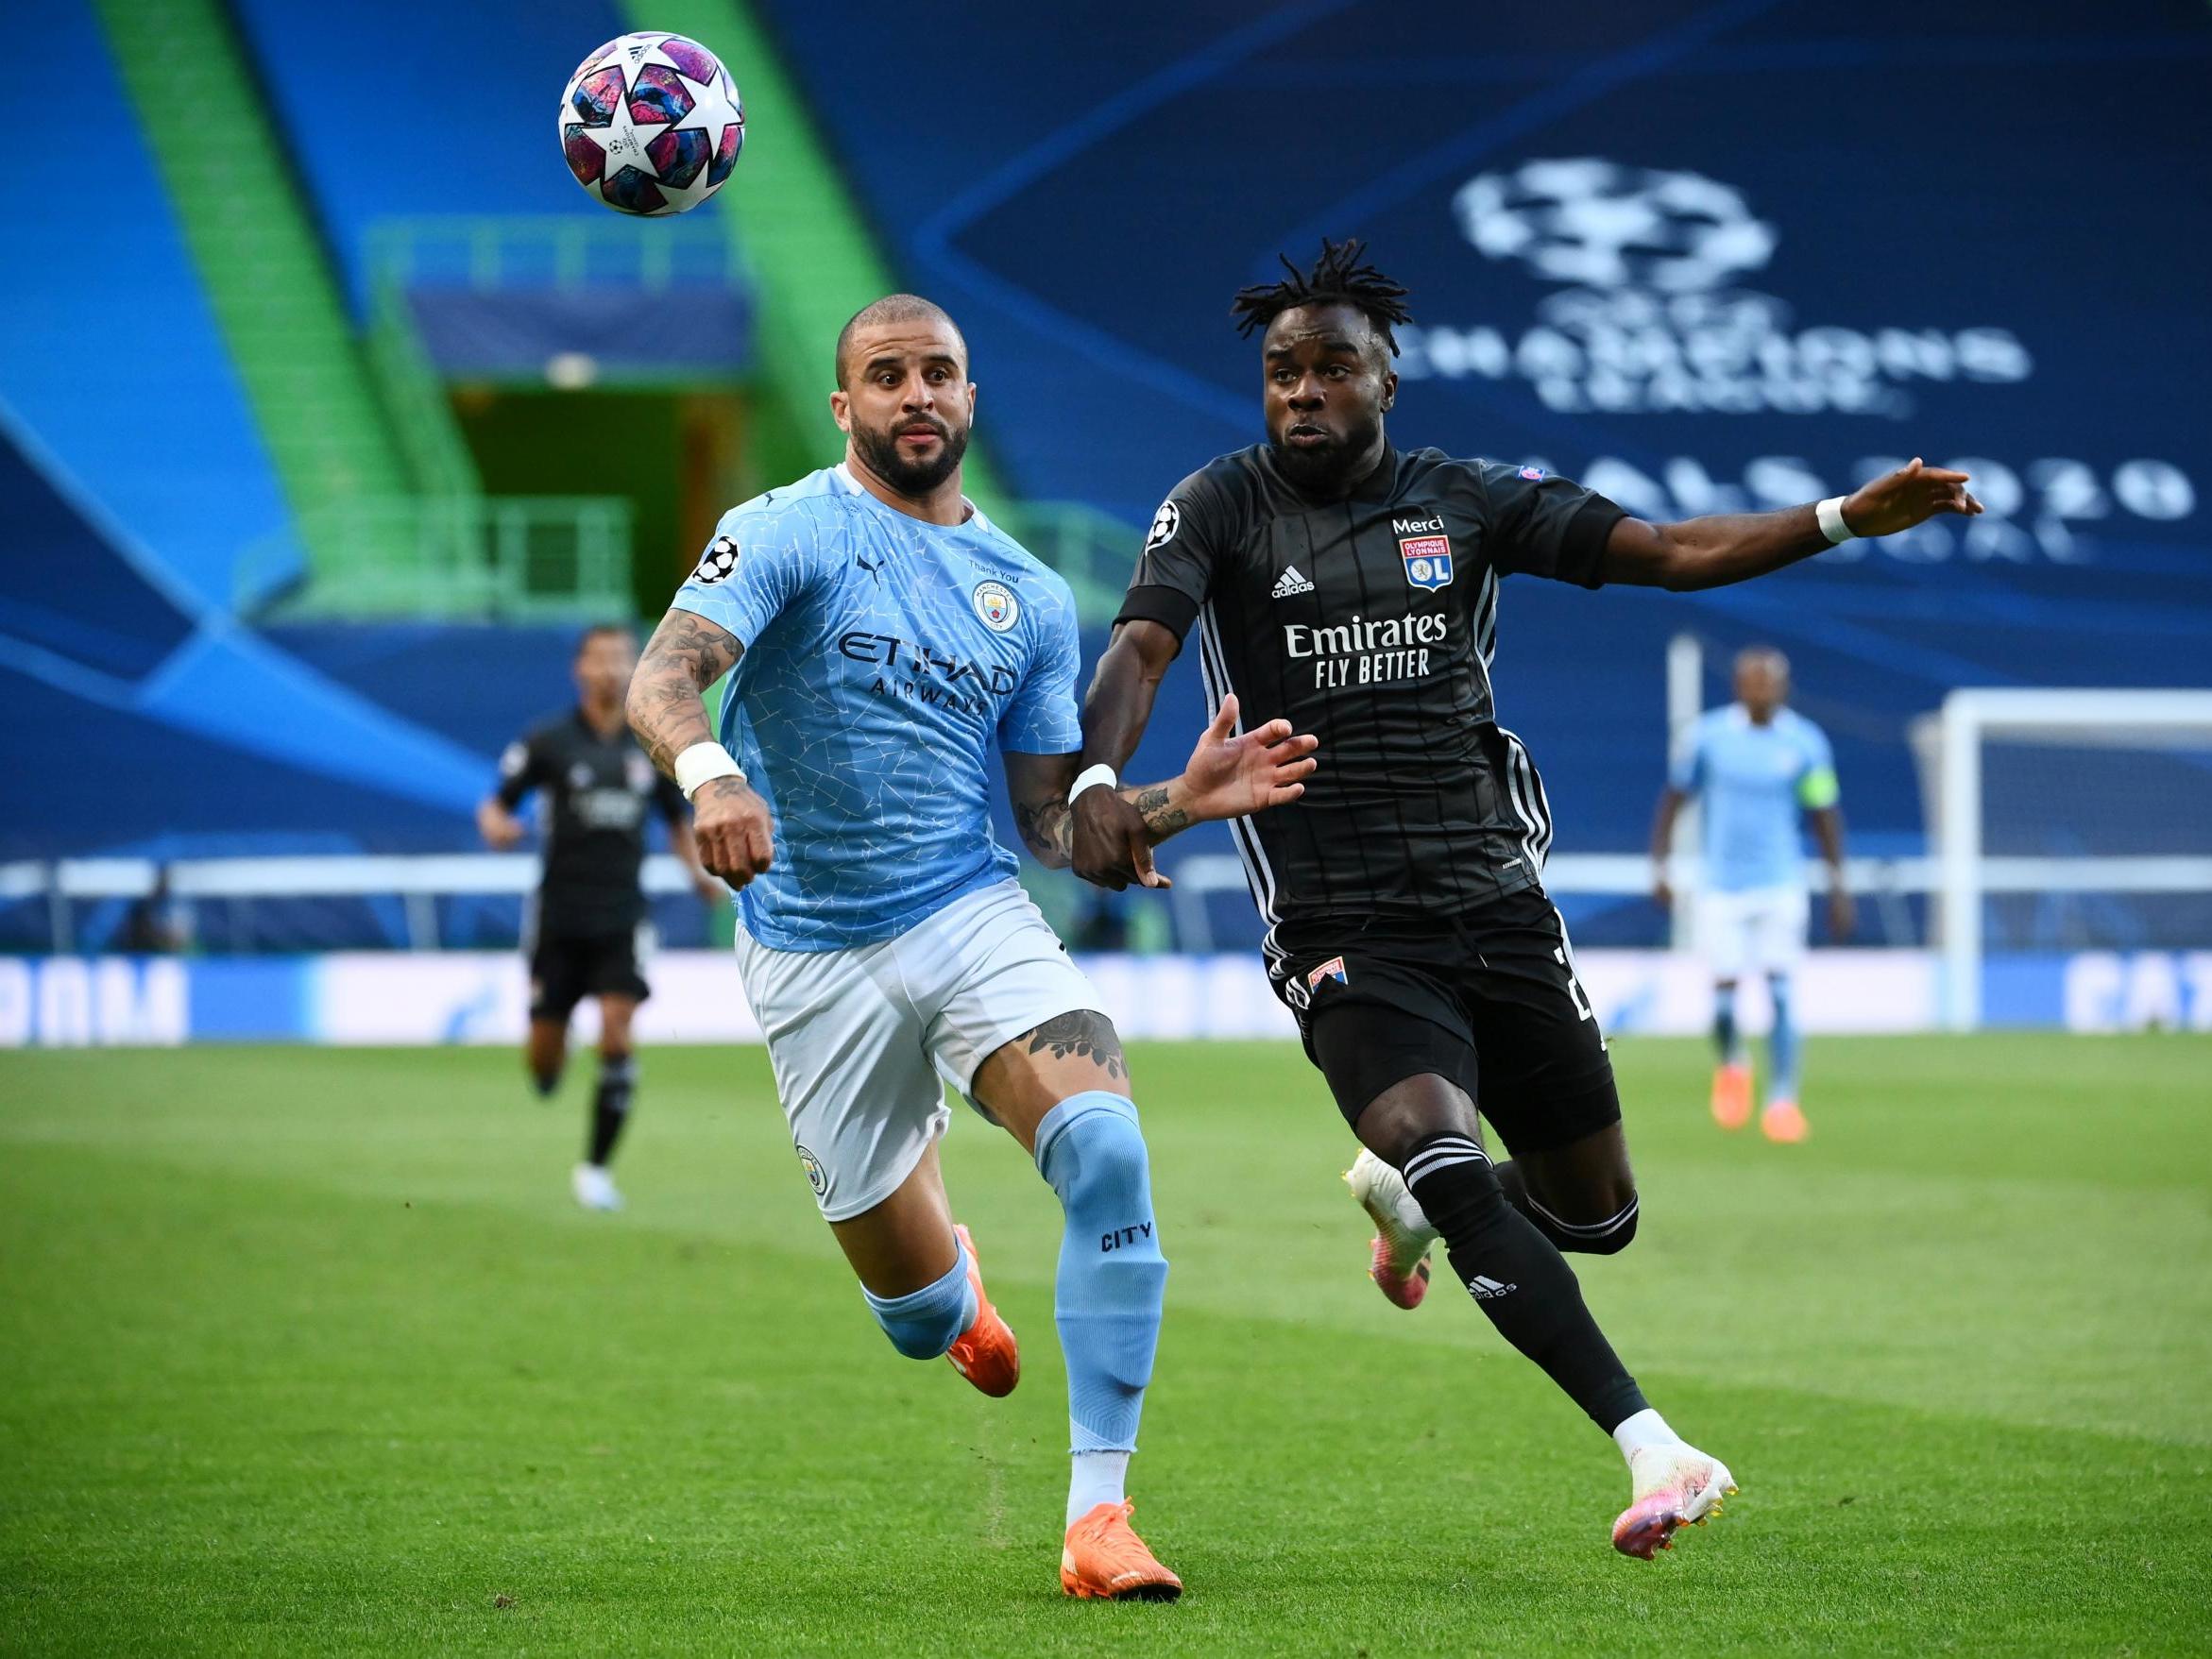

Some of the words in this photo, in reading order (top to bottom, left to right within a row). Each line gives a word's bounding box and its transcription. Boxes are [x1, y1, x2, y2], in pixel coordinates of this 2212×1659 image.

[1392, 515, 1444, 534] Merci
[1404, 539, 1444, 550] OLYMPIQUE
[1406, 546, 1446, 556] LYONNAIS
[969, 560, 996, 578] Thank
[1000, 570, 1019, 584] You
[976, 584, 1013, 602] MANCHESTER
[1271, 581, 1315, 599] adidas
[1284, 613, 1447, 658] Emirates
[839, 631, 1015, 695] ETIHAD
[1316, 658, 1350, 689] FLY
[1358, 648, 1430, 685] BETTER
[870, 677, 988, 716] AIRWAYS
[1101, 1221, 1151, 1253] CITY
